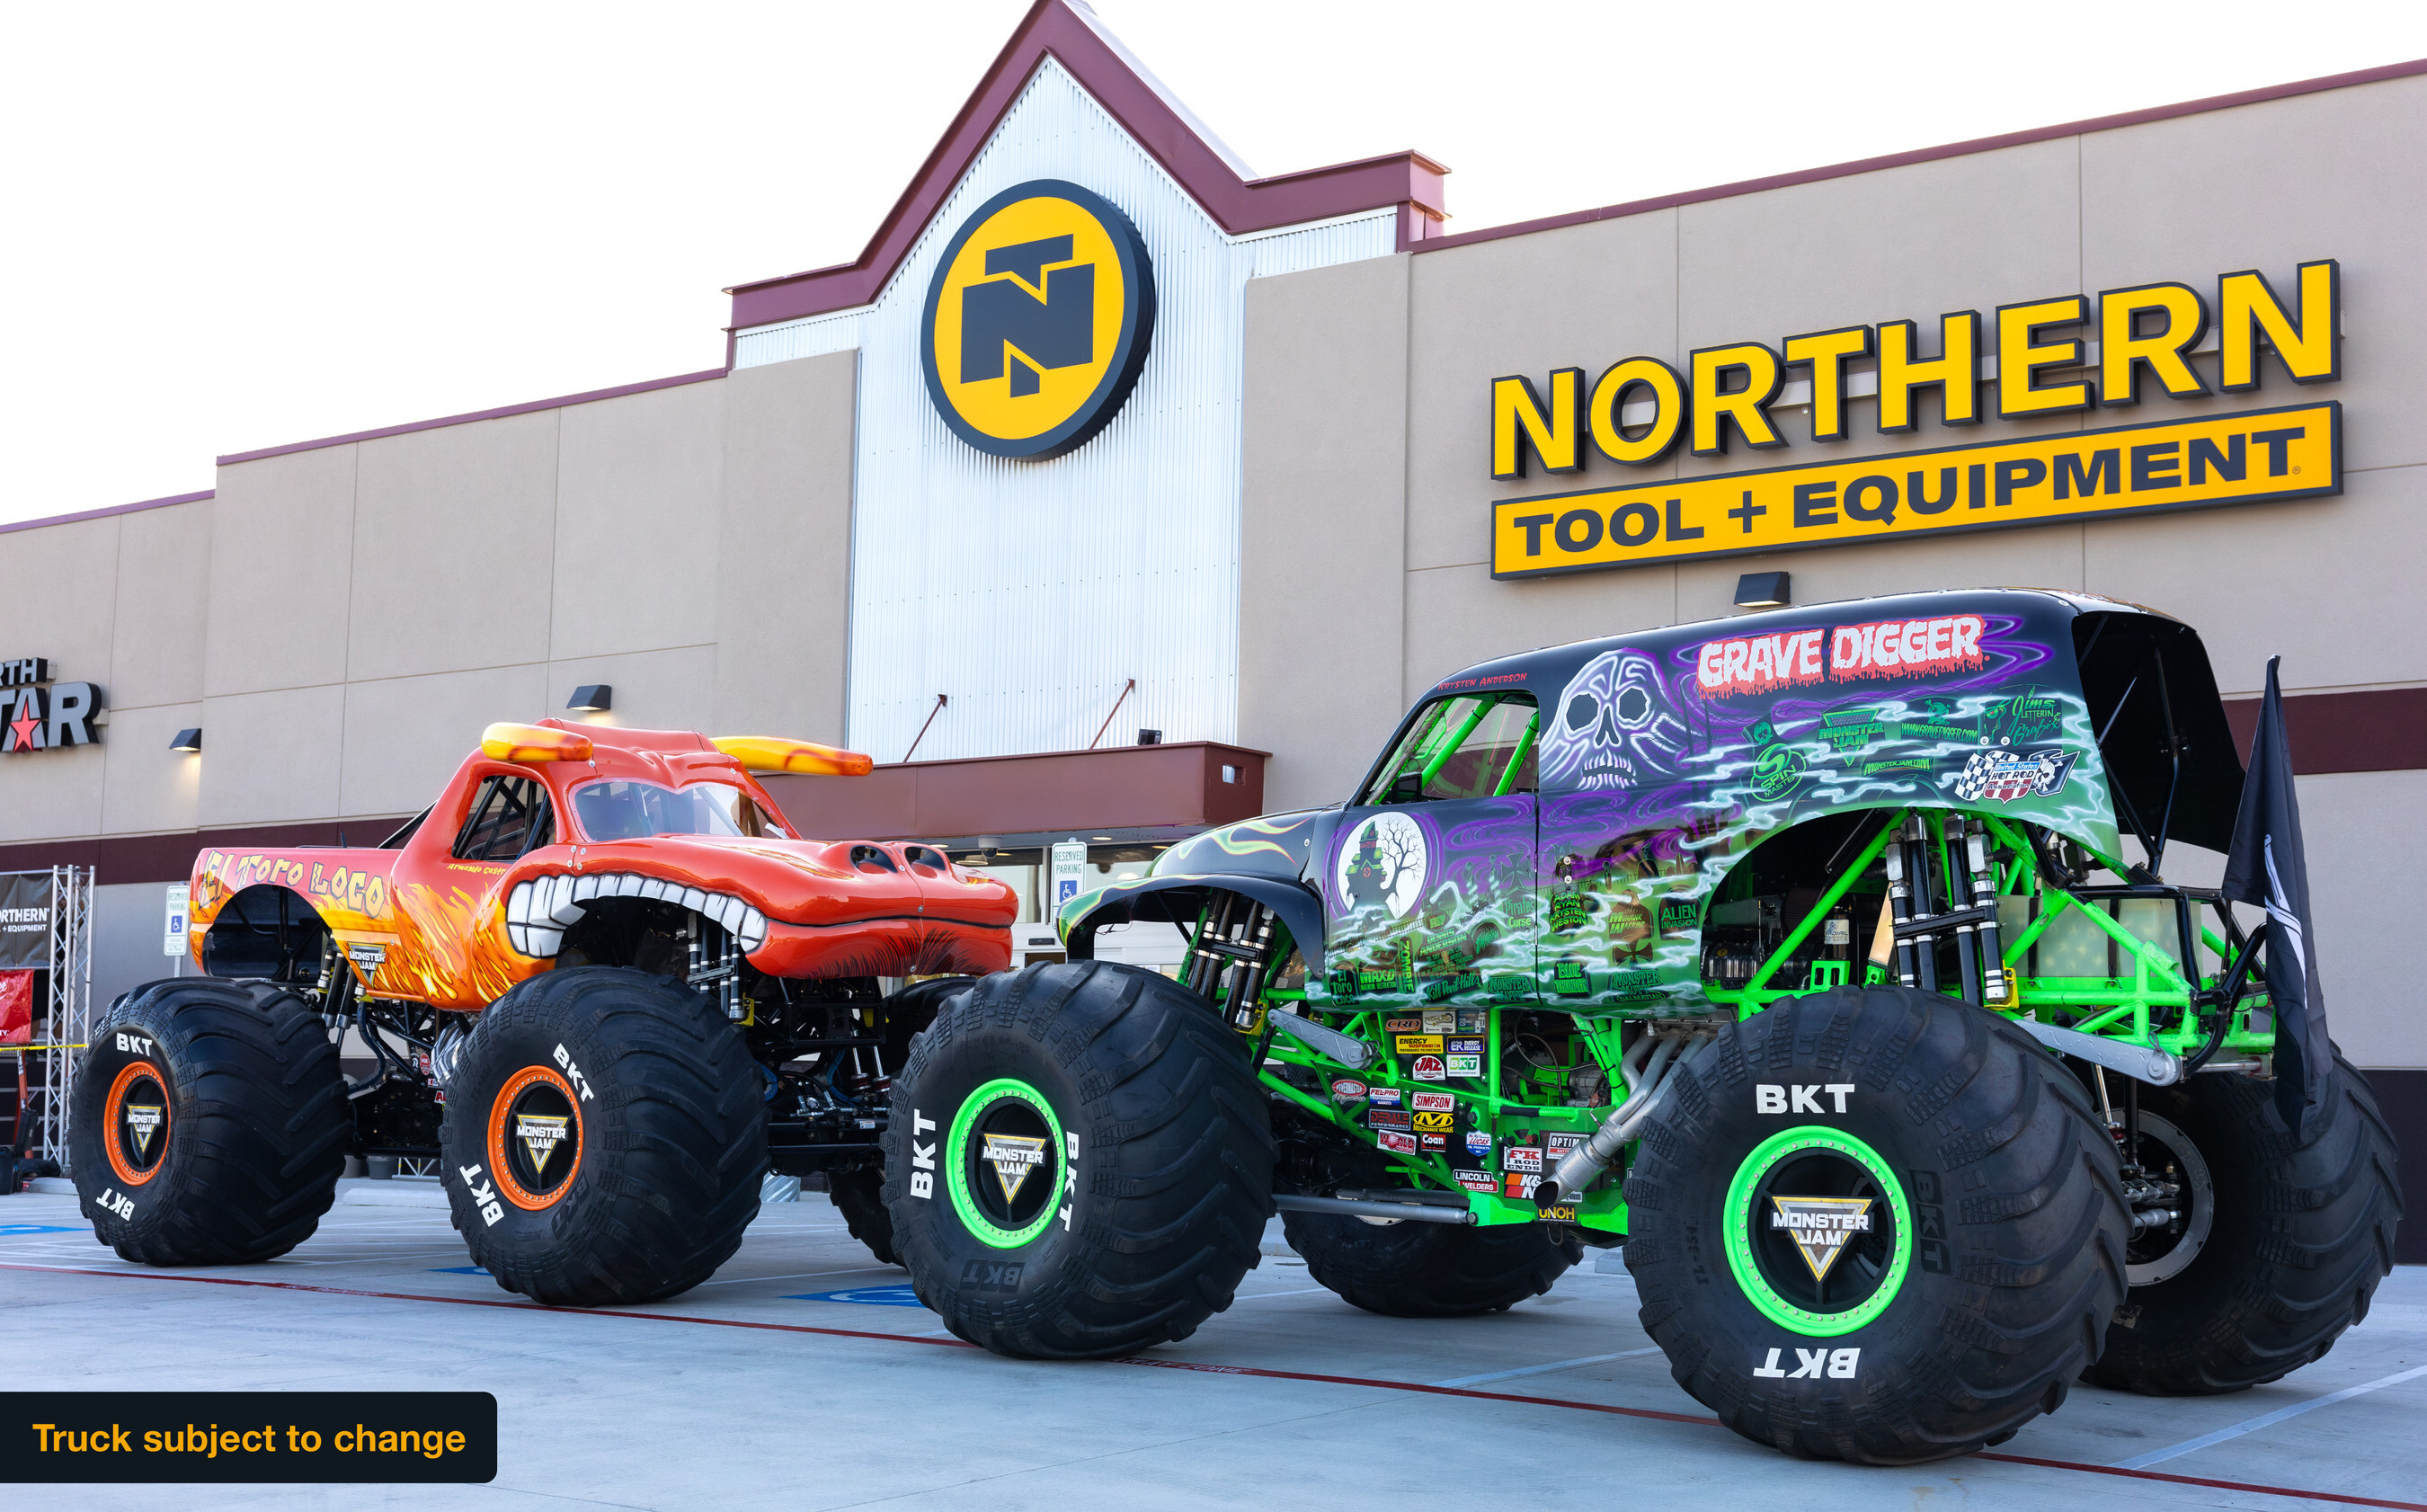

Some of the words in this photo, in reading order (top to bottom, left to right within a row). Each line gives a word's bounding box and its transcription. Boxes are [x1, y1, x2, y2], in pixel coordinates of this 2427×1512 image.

[1492, 259, 2338, 480] NORTHERN
[1513, 502, 1705, 556] TOOL
[1793, 426, 2307, 528] EQUIPMENT
[1698, 629, 1824, 692] GRAVE
[1831, 616, 1984, 674] DIGGER
[1438, 679, 1477, 690] KRYSTEN
[1480, 673, 1527, 687] ANDERSON
[1818, 722, 1885, 739] MONSTER
[1834, 734, 1869, 748] JAM
[1761, 764, 1798, 790] SPIN
[1992, 771, 2012, 780] HOT
[2013, 770, 2034, 778] ROD
[1764, 771, 1801, 797] MASTER
[1054, 850, 1084, 861] RESERVED
[1055, 864, 1081, 875] PARKING
[1553, 892, 1580, 903] ADAM
[1555, 900, 1580, 911] RYAN
[1661, 904, 1697, 921] ALIEN
[1508, 917, 1532, 928] Curse
[1550, 907, 1587, 923] KRYSTEN
[8, 924, 48, 932] EQUIPMENT
[1551, 916, 1587, 931] WESTON
[1661, 919, 1697, 929] INVASION
[1420, 934, 1467, 956] ANDERSON
[349, 950, 386, 963] MONSTER
[360, 961, 377, 970] JAM
[1400, 940, 1415, 993] ZOMBIE
[1557, 963, 1582, 978] BLUE
[1489, 977, 1530, 991] MONSTER
[1554, 977, 1588, 993] THUNDER
[1614, 971, 1661, 986] MONSTER
[117, 1033, 153, 1057] BKT
[1415, 1057, 1442, 1072] JAZ
[1449, 1057, 1477, 1070] BKT
[553, 1043, 594, 1102] BKT
[1416, 1095, 1451, 1108] SIMPSON
[1756, 1084, 1854, 1114] BKT
[128, 1114, 160, 1125] MONSTER
[137, 1124, 153, 1134] JAM
[517, 1125, 566, 1139] MONSTER
[1413, 1125, 1438, 1133] MECHANIX
[529, 1138, 553, 1149] JAM
[1422, 1134, 1445, 1145] Coan
[910, 1108, 936, 1199] BKT
[983, 1145, 1044, 1163] MONSTER
[1509, 1151, 1540, 1160] FK
[999, 1162, 1026, 1176] JAM
[1059, 1131, 1079, 1232] BKT
[1455, 1172, 1490, 1182] LINCOLN
[1462, 1182, 1493, 1191] WELDERS
[459, 1164, 504, 1227] BKT
[96, 1187, 135, 1221] BKT
[1539, 1207, 1575, 1219] UNOH
[1774, 1213, 1869, 1230] MONSTER
[1800, 1231, 1843, 1245] JAM
[961, 1260, 1024, 1290] BKT
[1753, 1347, 1861, 1379] BKT
